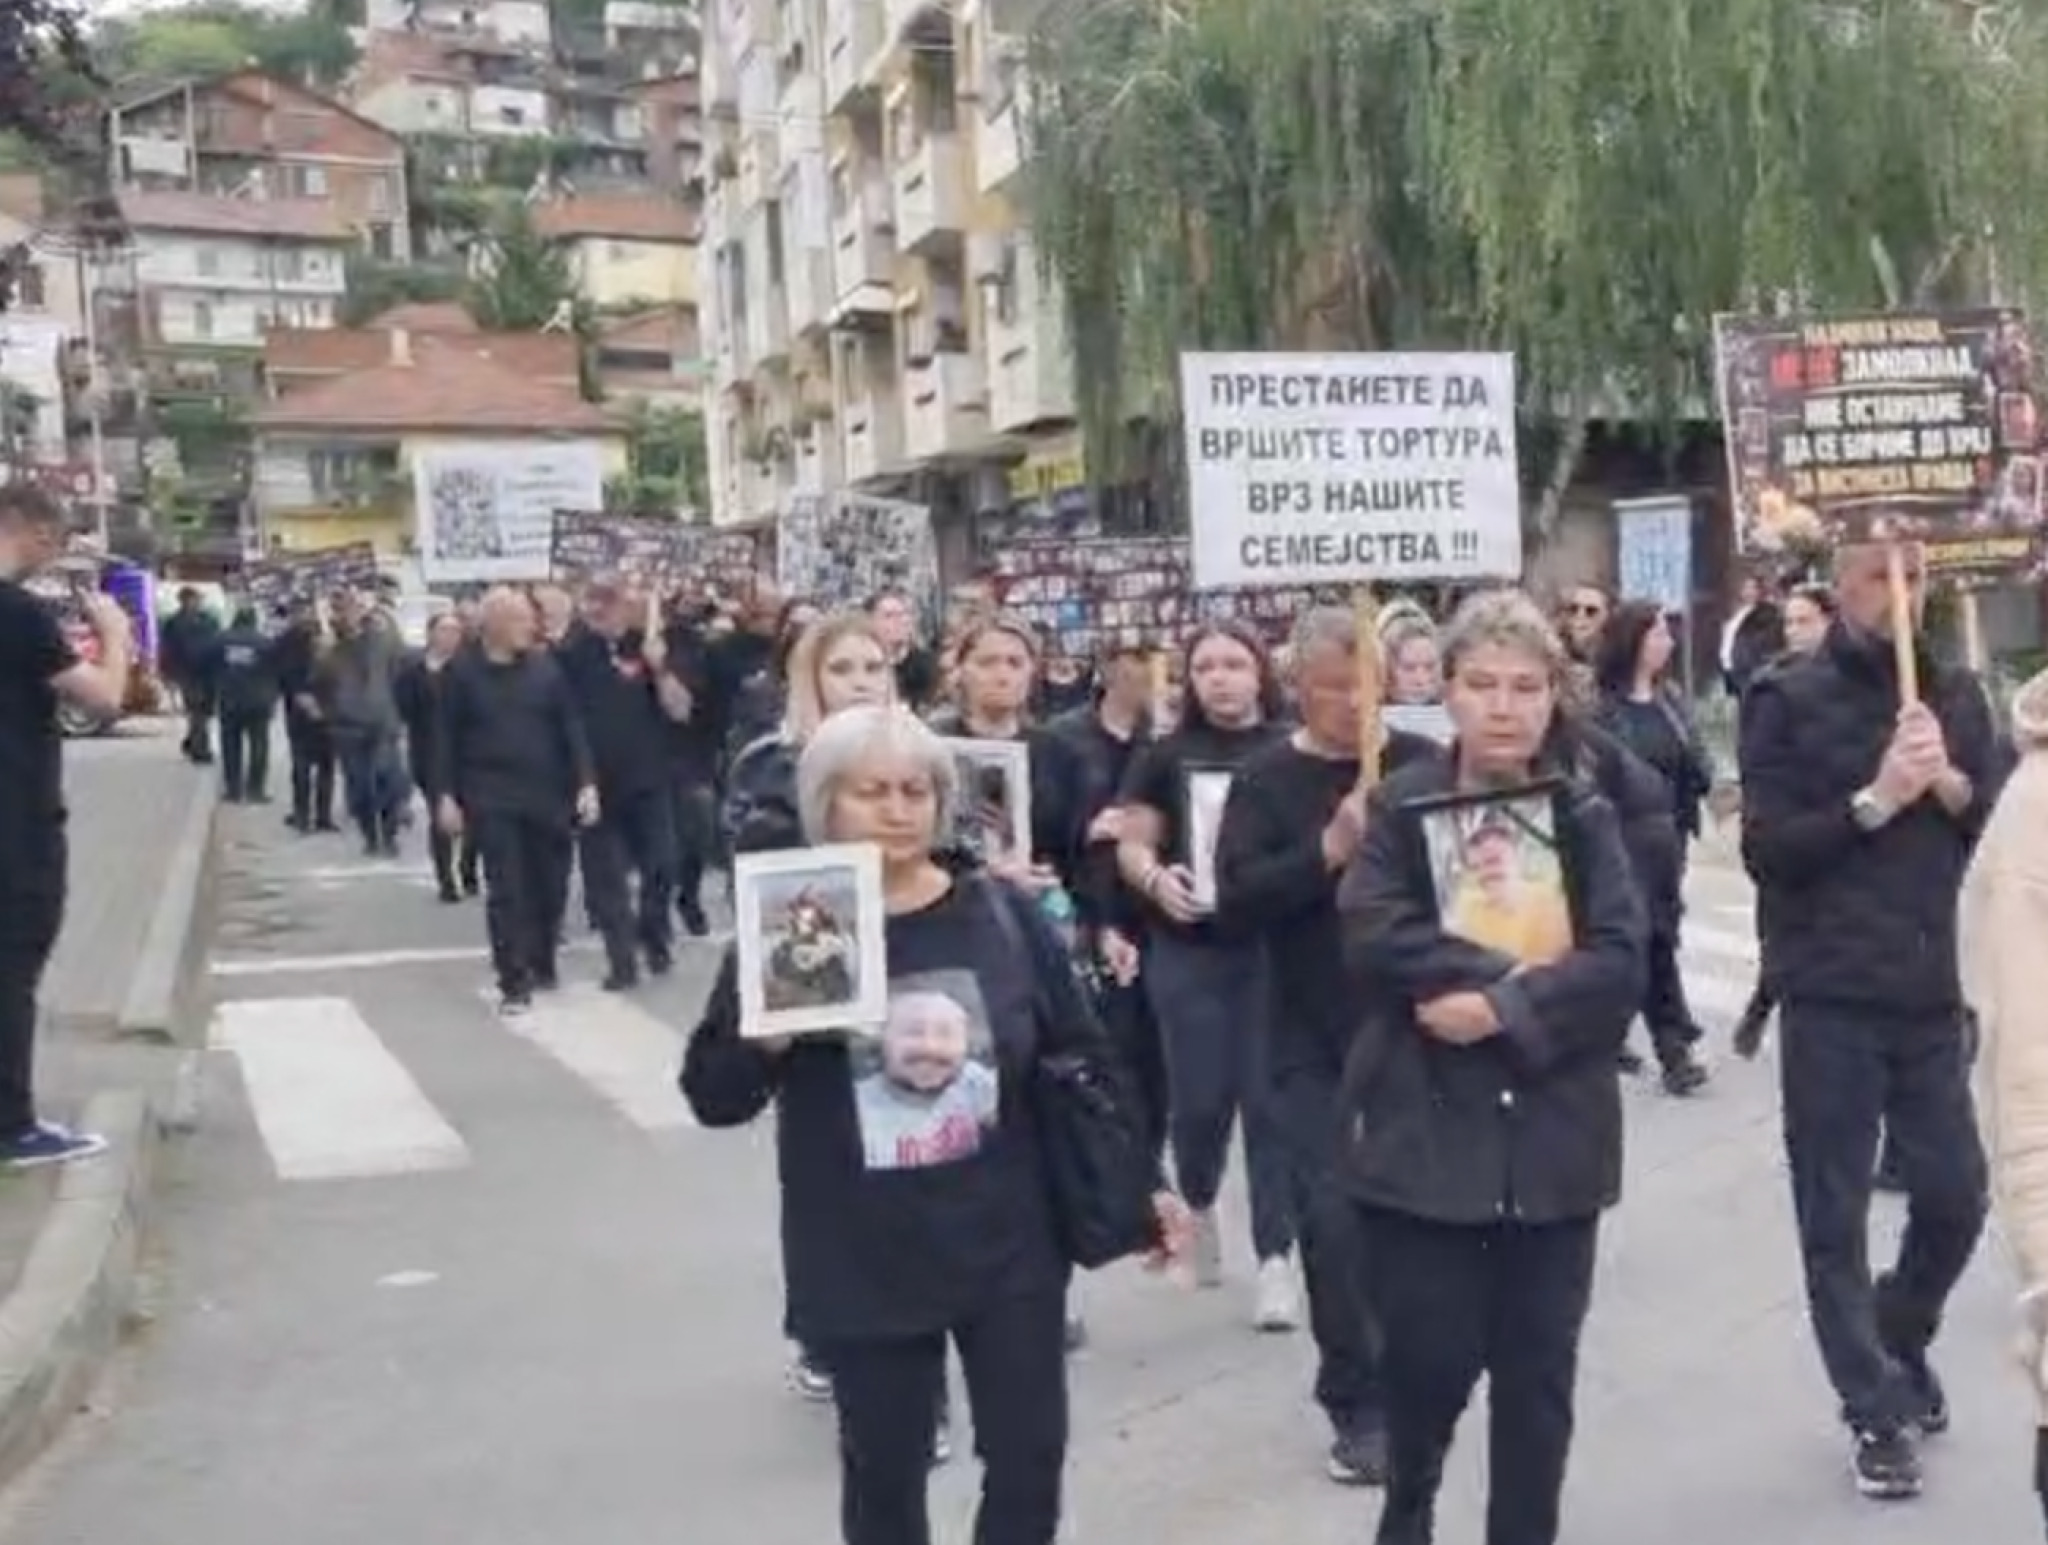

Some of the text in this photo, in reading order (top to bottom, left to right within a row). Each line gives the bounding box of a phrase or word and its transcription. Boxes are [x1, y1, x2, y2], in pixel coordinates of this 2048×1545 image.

[1210, 374, 1488, 411] ПРЕСТАНЕТЕ ДА
[1200, 427, 1503, 460] ВРШИТЕ ТОРТУРА
[1248, 480, 1465, 513] ВРЗ НАШИТЕ
[1240, 530, 1479, 567] СЕМЕЈСТВА !!!
